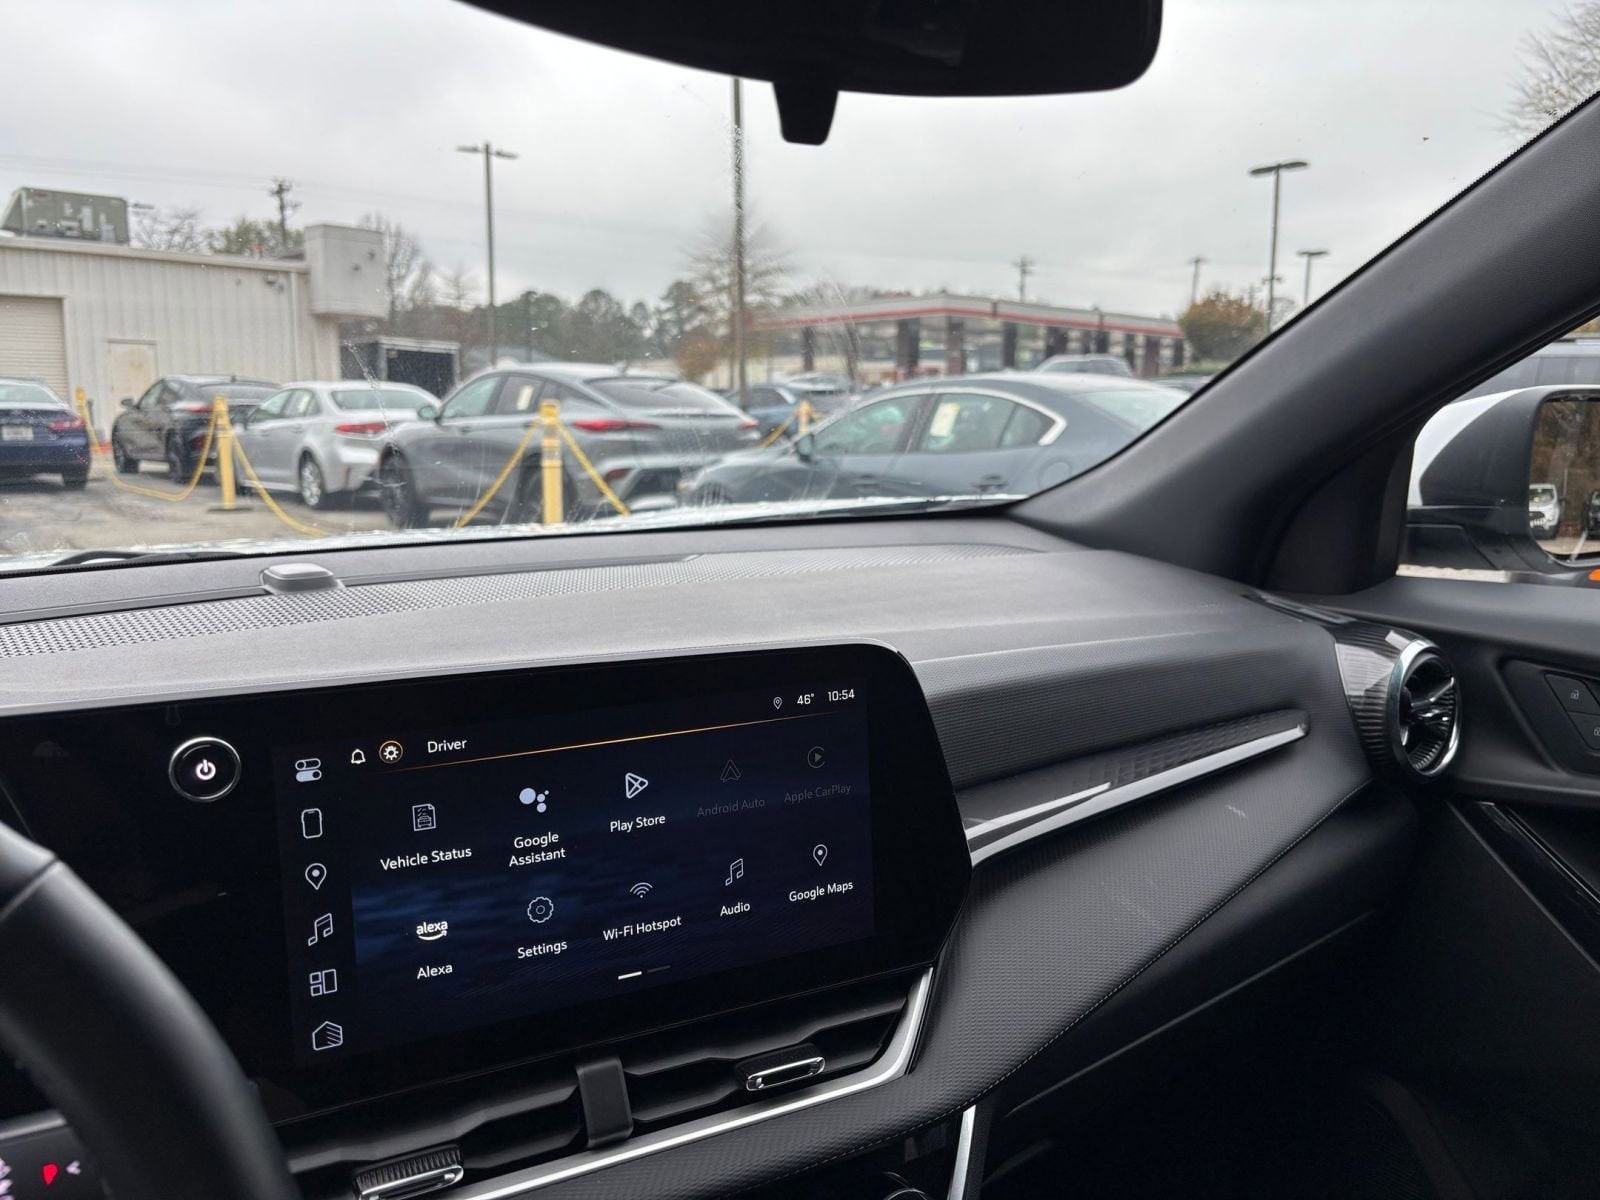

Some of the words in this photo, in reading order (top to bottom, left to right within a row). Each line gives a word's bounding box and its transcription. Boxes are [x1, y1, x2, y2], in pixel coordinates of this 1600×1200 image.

[827, 688, 855, 702] 10:54
[426, 738, 468, 753] Driver
[784, 791, 813, 804] Apple
[815, 783, 851, 799] CarPlay
[697, 800, 739, 818] Android
[741, 797, 766, 811] Auto
[609, 820, 634, 833] Play
[635, 814, 666, 829] Store
[513, 831, 559, 850] Google
[379, 852, 429, 871] Vehicle
[431, 847, 472, 863] Status
[508, 847, 566, 867] Assistant
[788, 885, 825, 902] Google
[826, 880, 854, 896] Maps
[719, 901, 751, 917] Audio
[416, 920, 448, 936] alexa
[602, 925, 634, 941] Wi-Fi
[635, 915, 682, 934] Hotspot
[517, 940, 568, 959] Settings
[416, 963, 453, 980] Alexa
